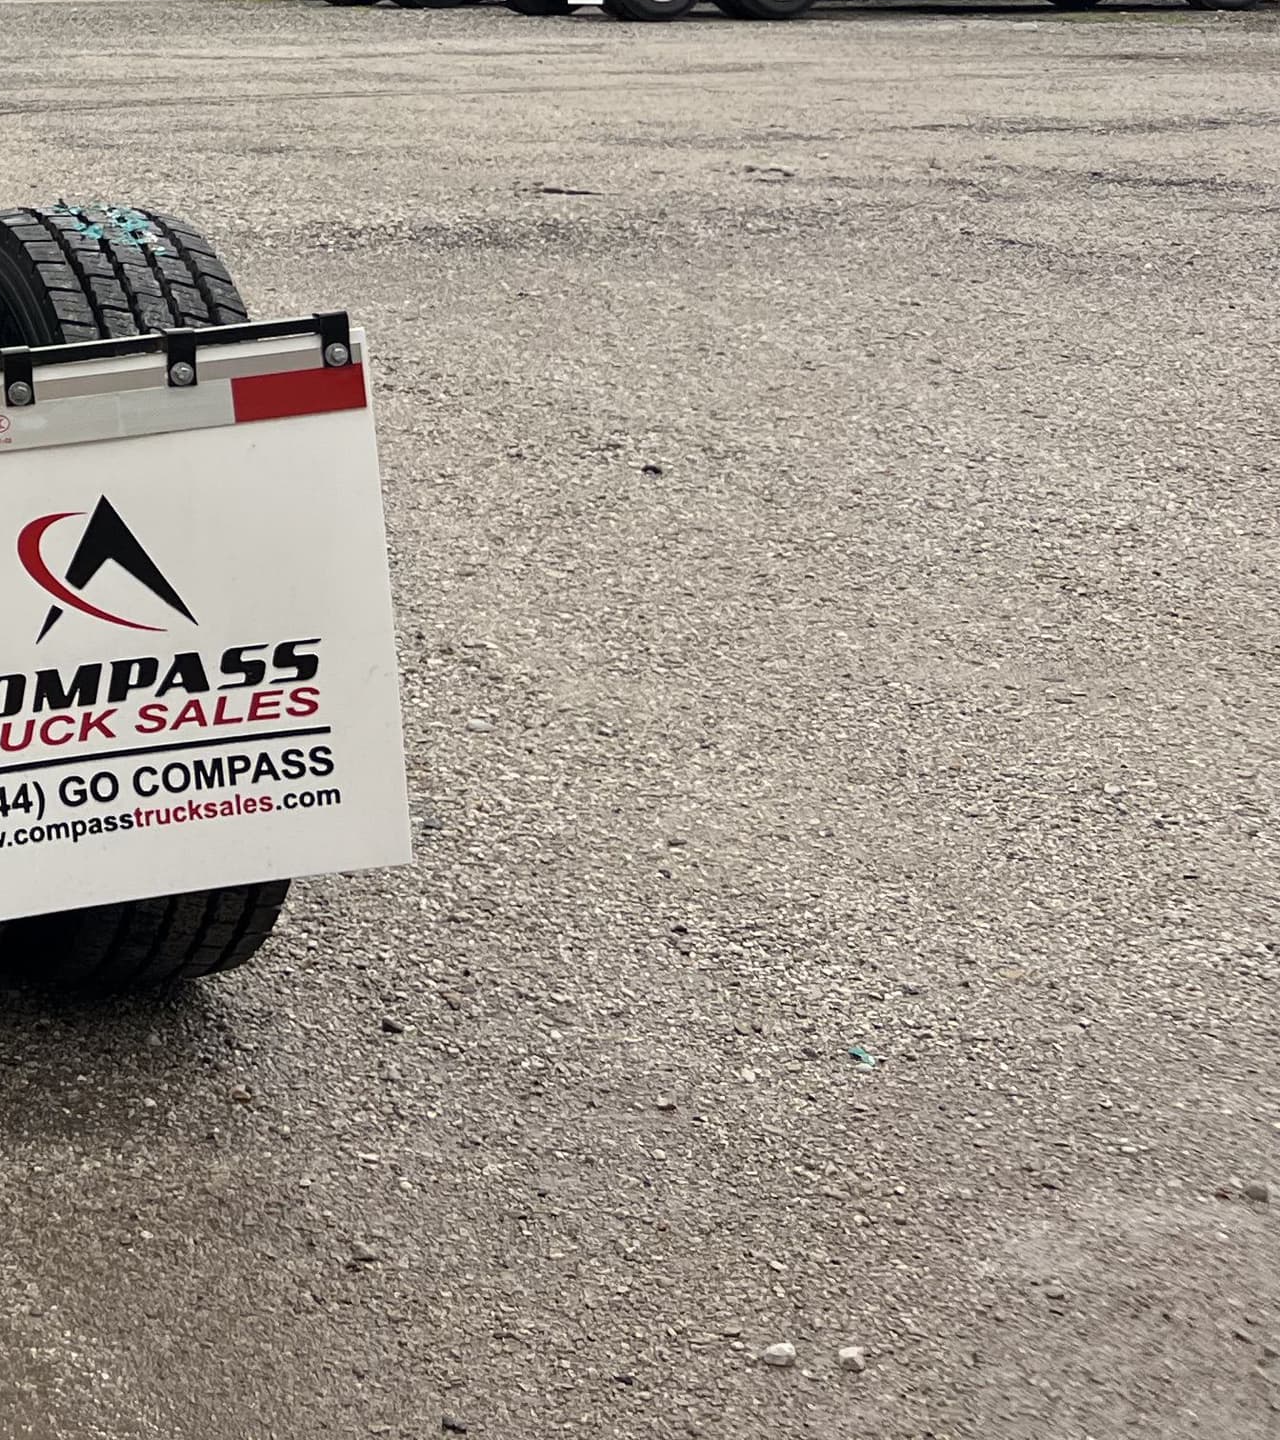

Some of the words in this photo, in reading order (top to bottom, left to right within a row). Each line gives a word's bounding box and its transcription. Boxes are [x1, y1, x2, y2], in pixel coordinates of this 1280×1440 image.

[134, 686, 321, 734] SALES
[58, 771, 120, 808] GO
[132, 745, 335, 798] COMPASS
